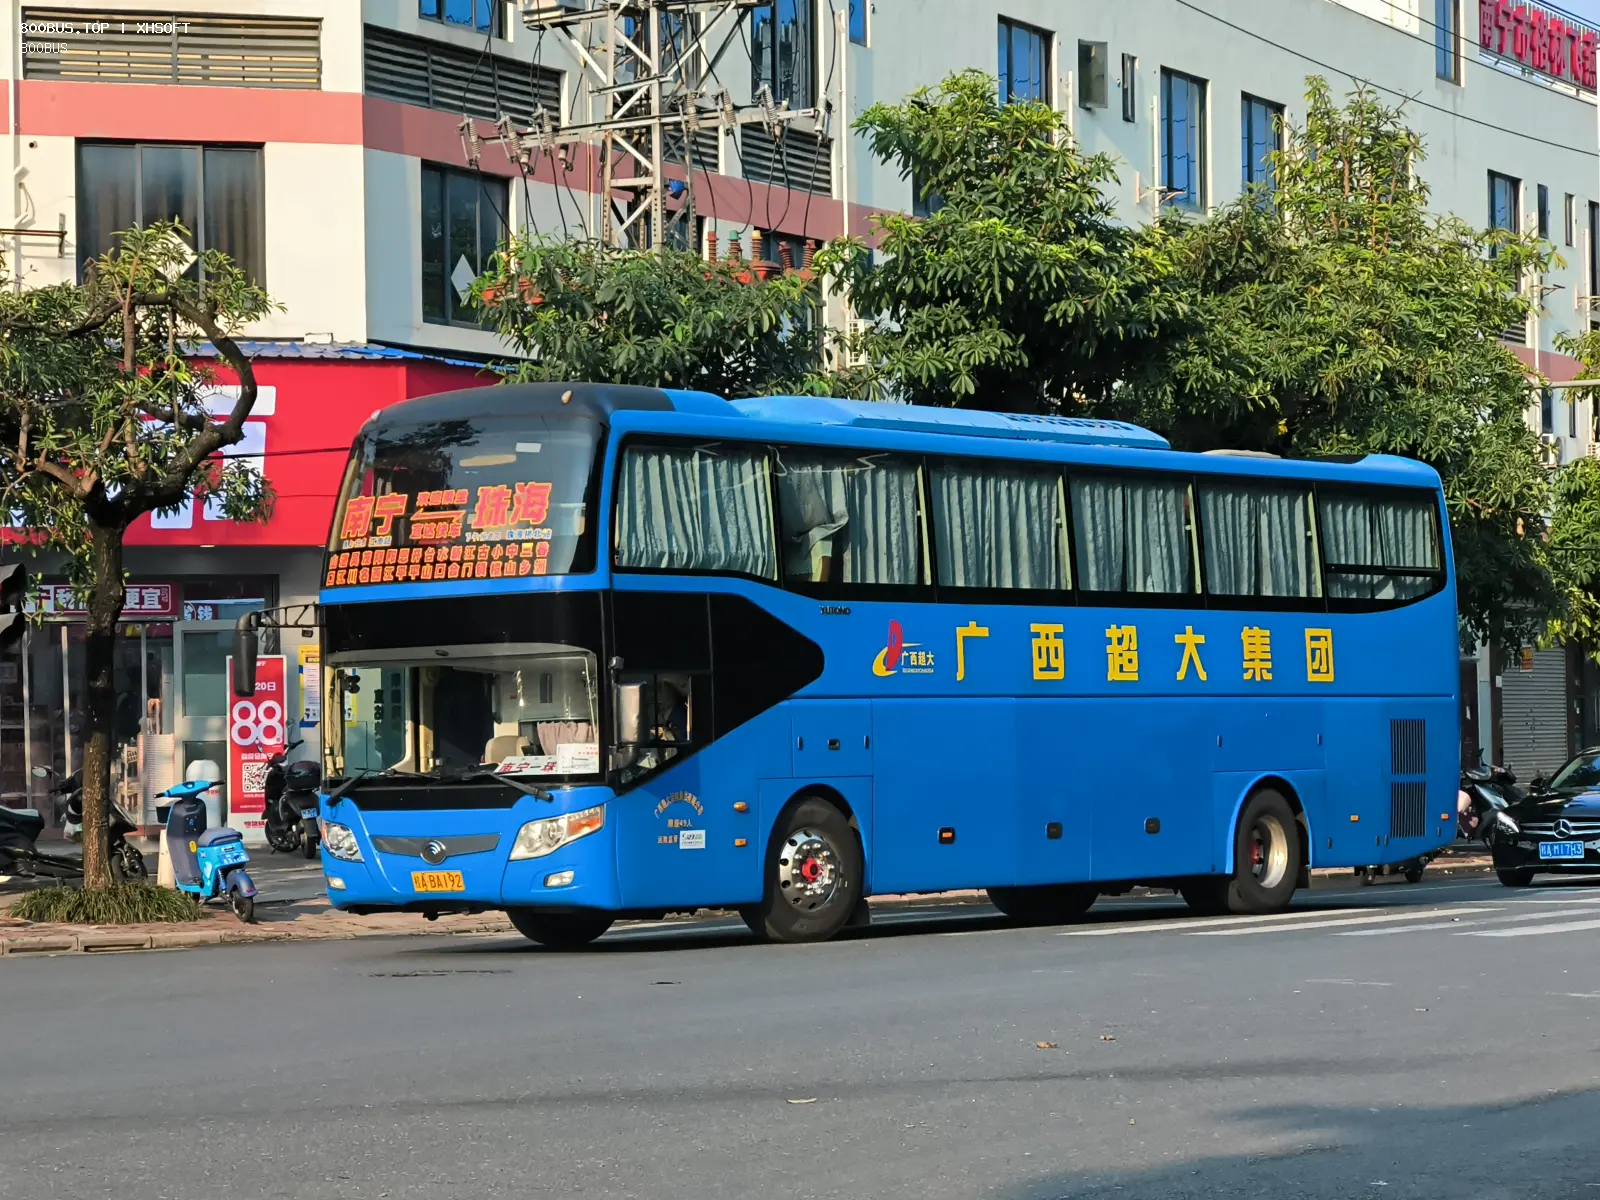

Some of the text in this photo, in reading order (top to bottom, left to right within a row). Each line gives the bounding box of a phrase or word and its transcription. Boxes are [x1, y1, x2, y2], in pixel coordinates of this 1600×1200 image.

[341, 493, 409, 540] 南宁
[471, 482, 553, 530] 珠海
[901, 650, 934, 666] 广西超大
[956, 620, 1336, 682] 广西超大集团
